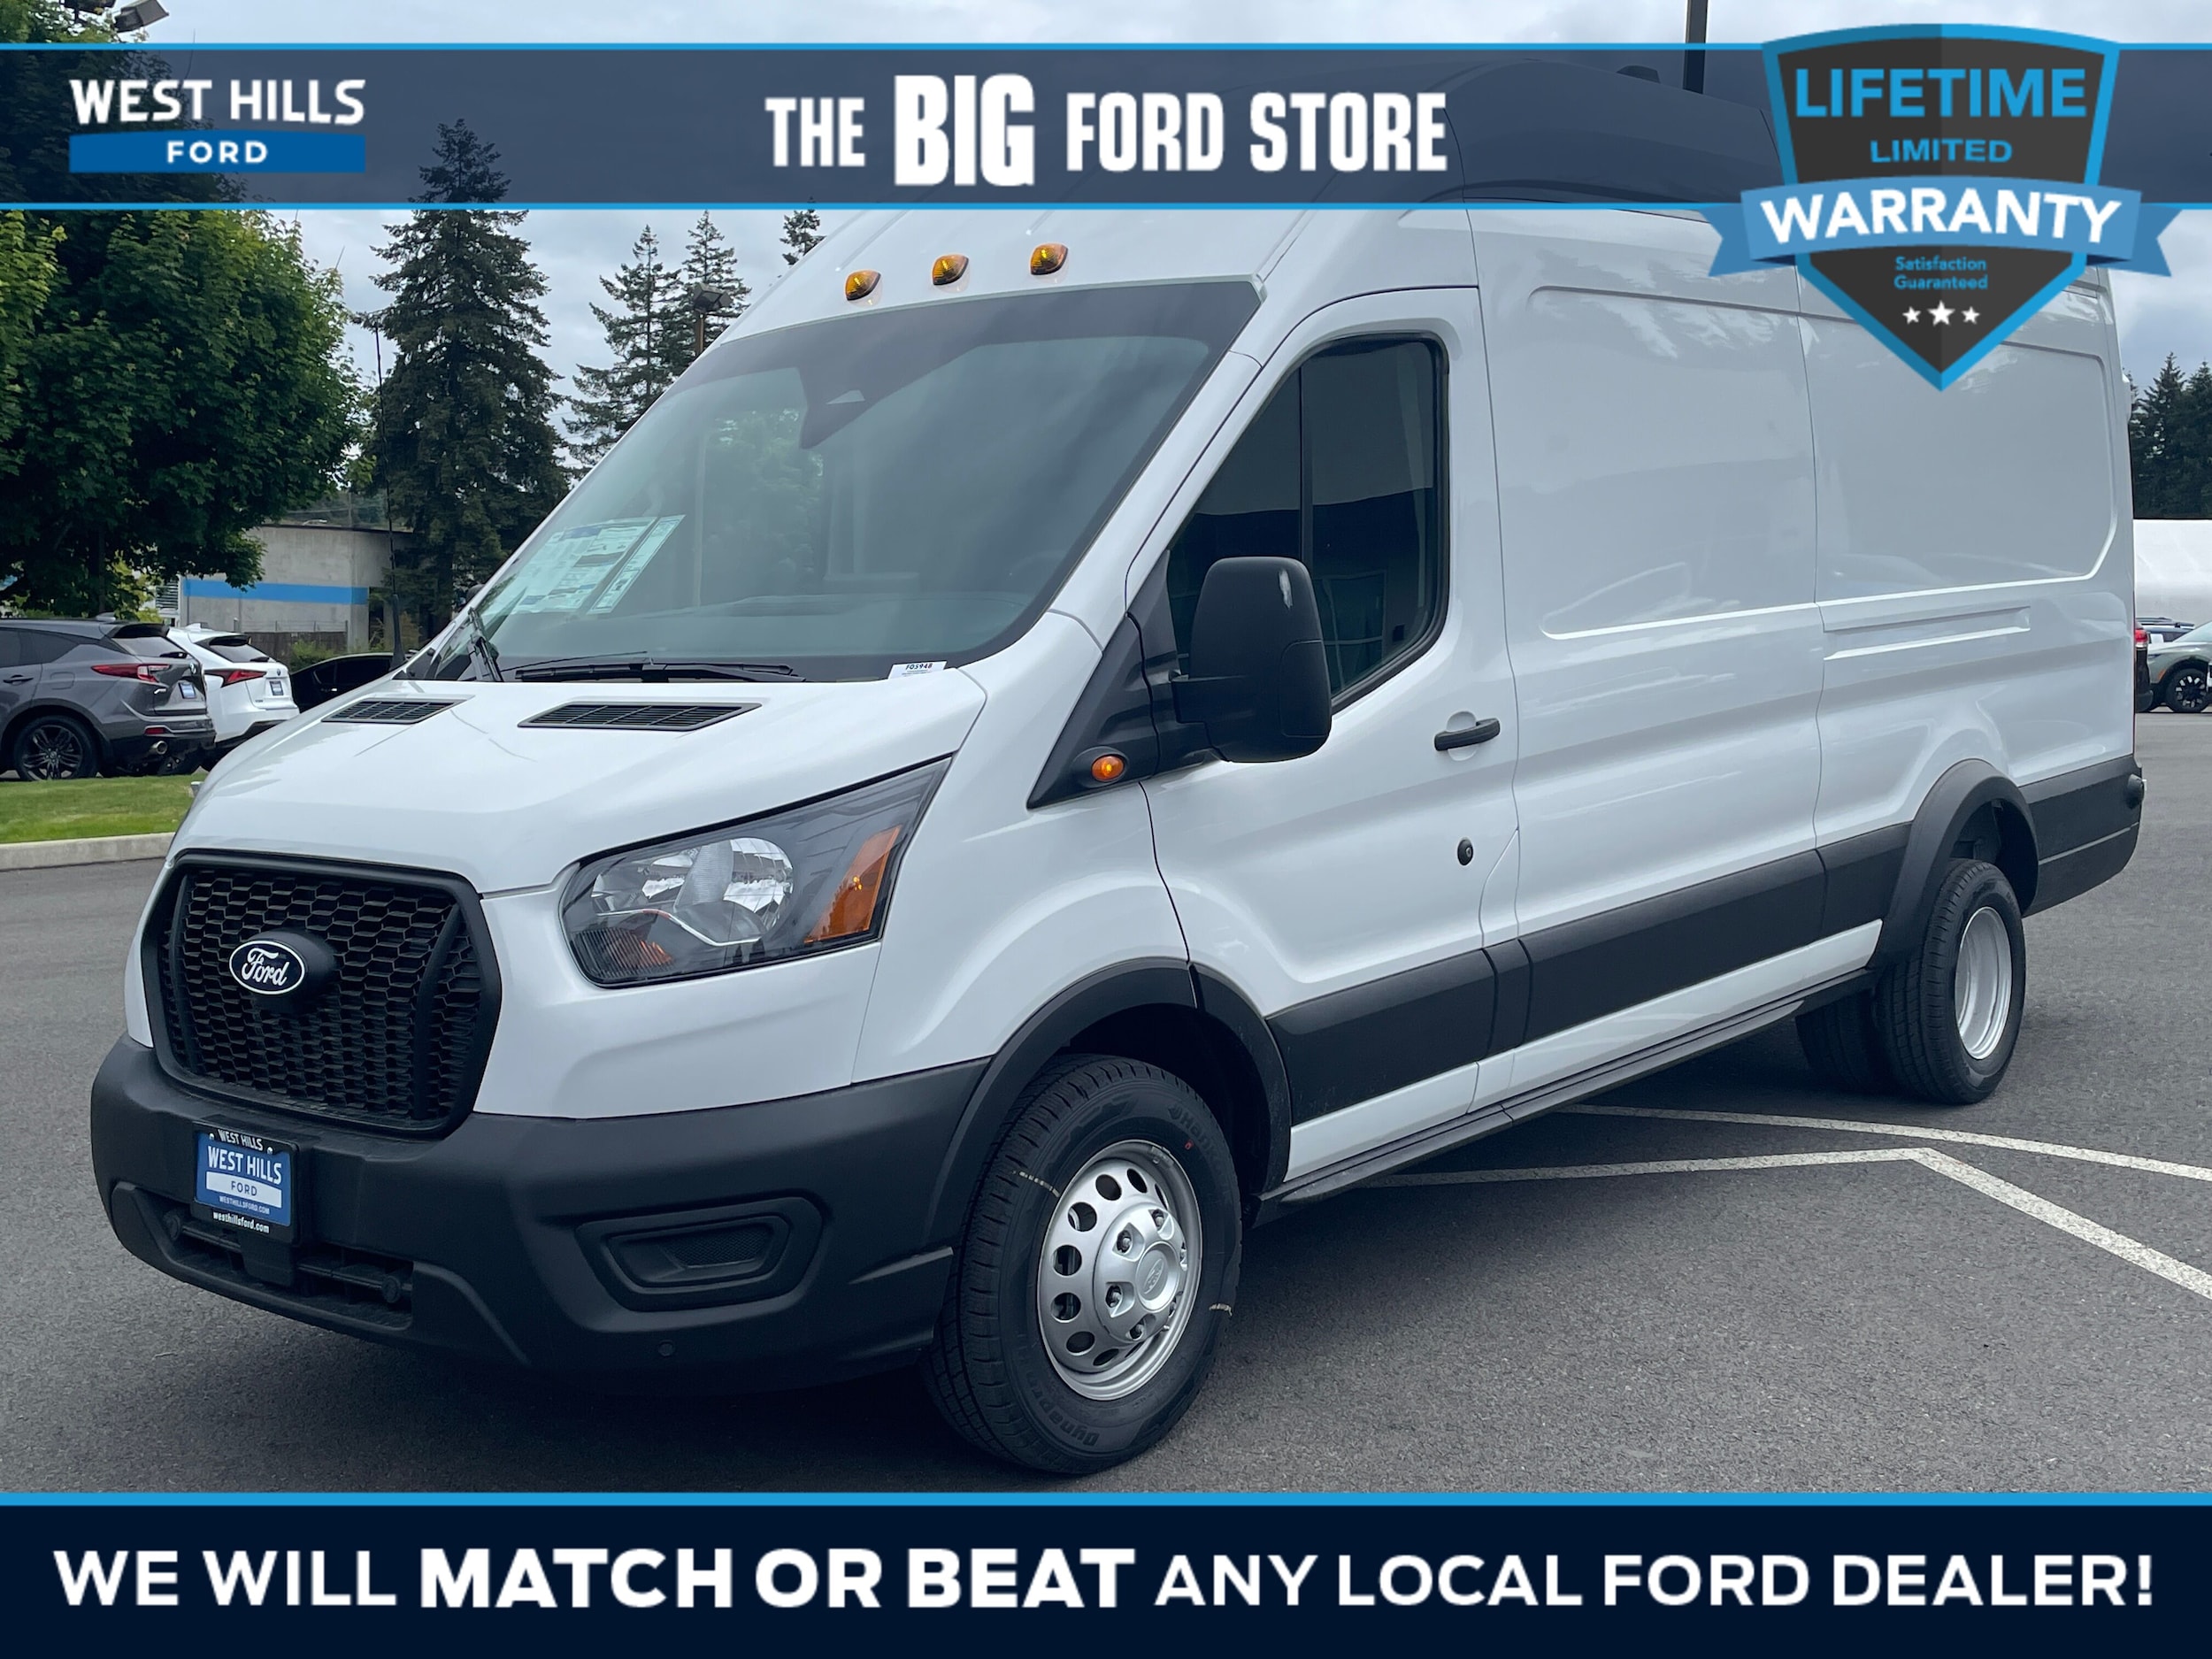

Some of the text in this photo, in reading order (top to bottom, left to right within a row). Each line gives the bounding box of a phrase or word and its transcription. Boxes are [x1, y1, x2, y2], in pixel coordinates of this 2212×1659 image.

[241, 947, 290, 987] Ford
[218, 1129, 264, 1151] WEST HILLS
[208, 1146, 282, 1185] WEST HILLS
[230, 1180, 257, 1196] FORD
[219, 1195, 270, 1215] WESTHILLSFORD.COM
[213, 1211, 270, 1233] westhillsford.com
